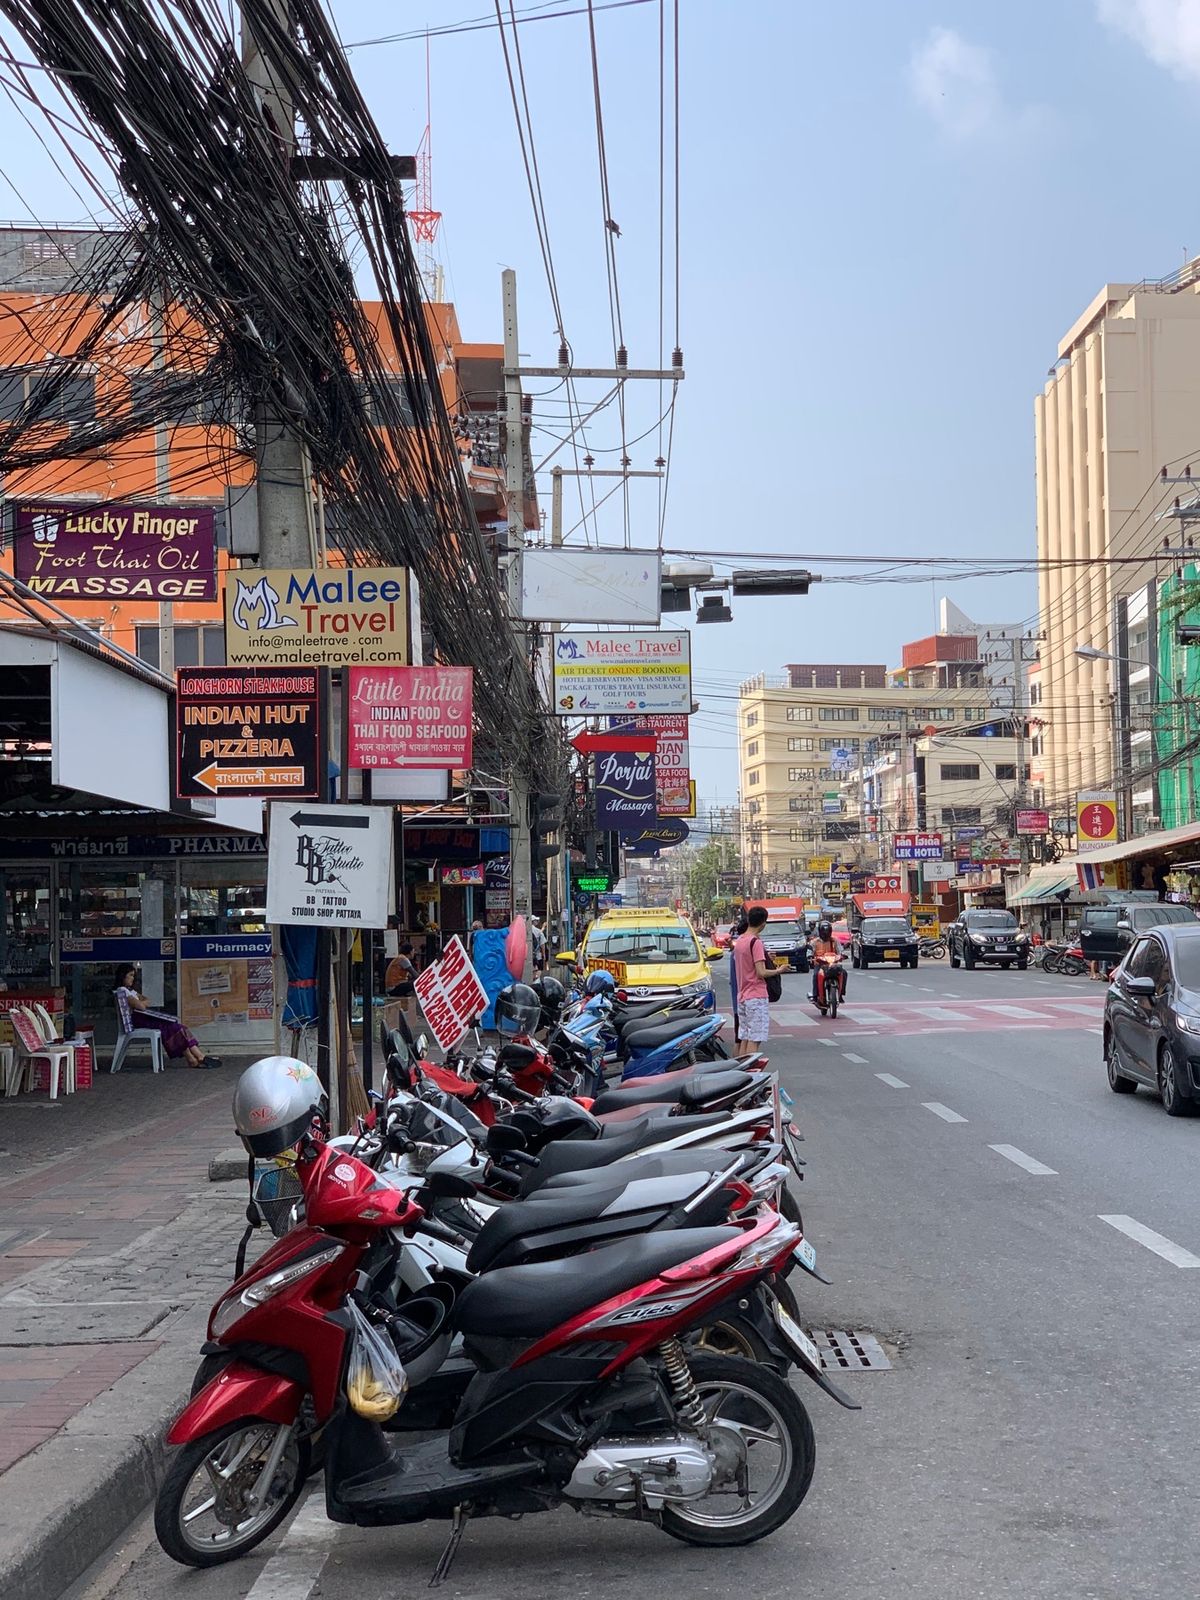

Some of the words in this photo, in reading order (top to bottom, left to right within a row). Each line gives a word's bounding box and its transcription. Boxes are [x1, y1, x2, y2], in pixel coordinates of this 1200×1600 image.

[65, 511, 129, 541] Lucky
[132, 511, 199, 542] Finger
[33, 542, 87, 571] Foot
[93, 543, 151, 569] Thai
[157, 545, 199, 570] Oil
[28, 575, 207, 596] MASSAGE
[286, 570, 401, 604] Malee
[301, 603, 395, 633] Travel
[586, 640, 631, 652] Malee
[635, 639, 682, 652] Travel
[231, 647, 401, 663] www.maleetravel.com
[560, 667, 575, 675] AIR
[643, 666, 681, 674] BOOKING
[181, 678, 242, 695] LONGHORN
[244, 677, 315, 694] STEAKHOUSE
[352, 677, 403, 705] Little
[410, 678, 463, 701] India
[184, 705, 260, 725] INDIAN
[265, 705, 310, 723] HUT
[371, 707, 408, 720] INDIAN
[411, 707, 441, 720] FOOD
[241, 725, 254, 738] &
[353, 724, 380, 738] THAI
[383, 725, 412, 738] FOOD
[416, 724, 467, 738] SEAFOOD
[200, 739, 294, 758] PIZZERIA
[656, 743, 684, 754] DIAN
[360, 755, 377, 764] 150
[380, 757, 391, 765] m.
[655, 754, 681, 765] OOD
[215, 769, 266, 784] বাংলাদেশী
[269, 772, 301, 784] খাবার
[600, 752, 652, 790] Porjai
[659, 769, 671, 777] SEA
[605, 798, 653, 816] Massage
[168, 836, 269, 854] PHARMA
[313, 835, 353, 854] Tattoo
[896, 848, 911, 857] LEK
[914, 847, 941, 857] HOTEL
[322, 853, 364, 873] Studio
[486, 859, 511, 877] Porj
[306, 896, 315, 904] BB
[322, 896, 347, 906] TATTOO
[292, 907, 315, 916] STUDIO
[317, 908, 334, 917] SHOP
[336, 909, 362, 919] PATTAYA
[206, 942, 271, 953] Pharmacy
[438, 939, 466, 989] FOR
[605, 960, 626, 976] RENT
[415, 967, 462, 1048] 084-1225369
[447, 970, 486, 1028] RENT
[612, 1304, 674, 1321] Click
